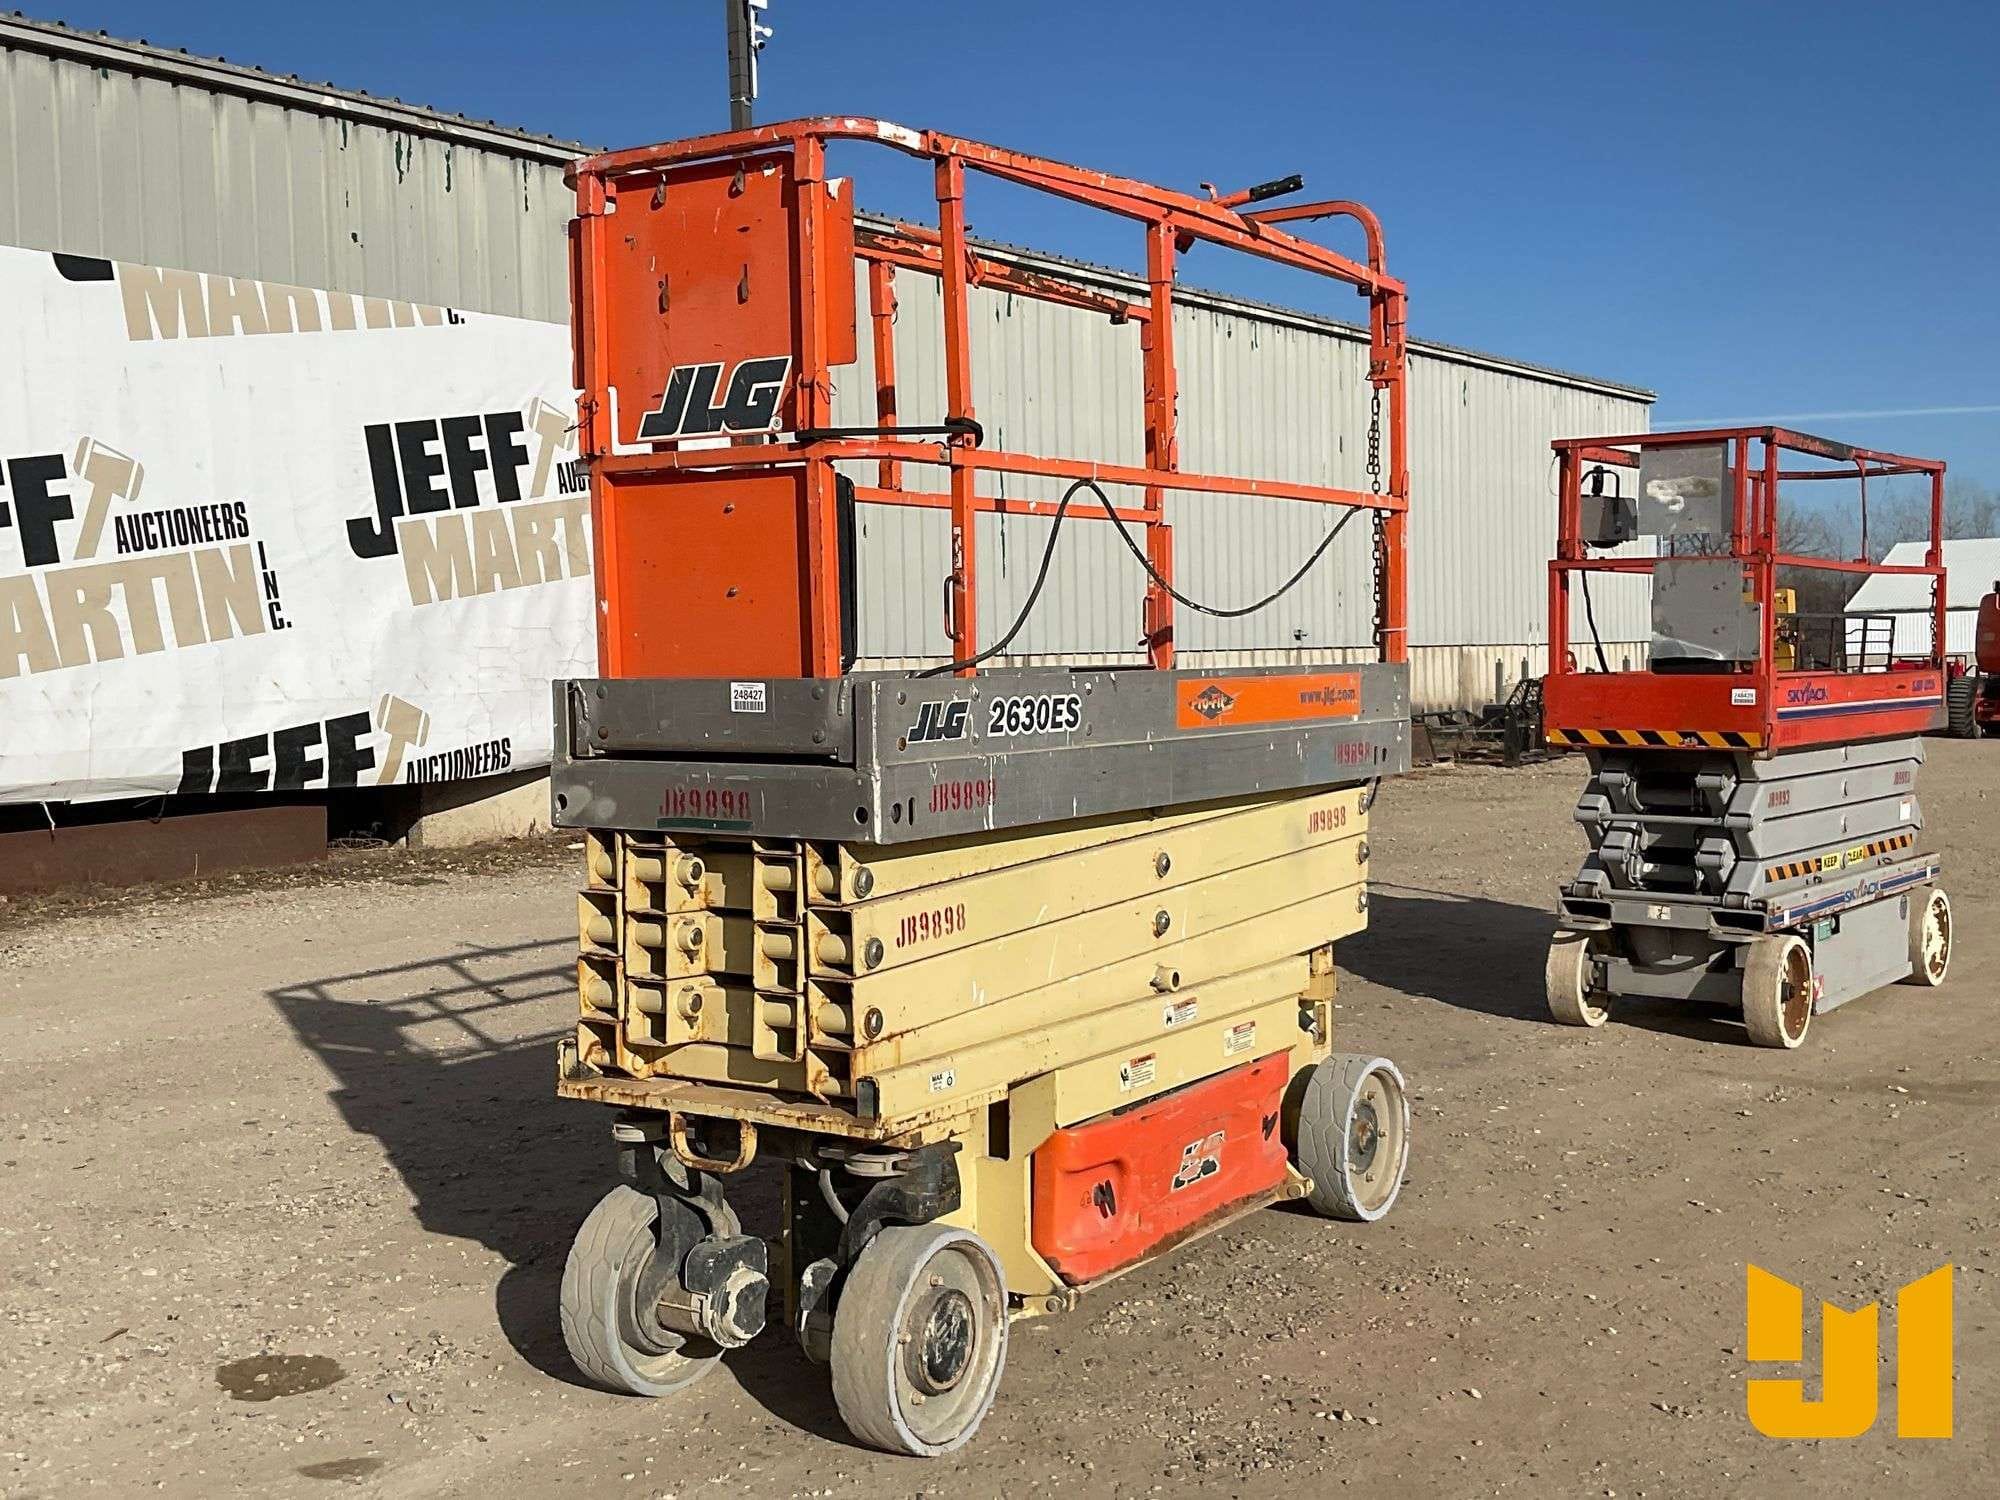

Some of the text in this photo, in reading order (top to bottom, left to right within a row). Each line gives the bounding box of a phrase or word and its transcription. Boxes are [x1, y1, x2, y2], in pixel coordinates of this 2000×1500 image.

[636, 355, 792, 441] JLG
[346, 411, 530, 559] JEFF
[114, 500, 250, 555] AUCTIONEERS
[257, 540, 293, 631] INC.
[733, 690, 763, 700] 248427
[907, 693, 1081, 744] JLG 2630ES
[1307, 805, 1347, 834] JB9898
[1823, 855, 1838, 869] KEEP
[896, 902, 967, 949] JB9898
